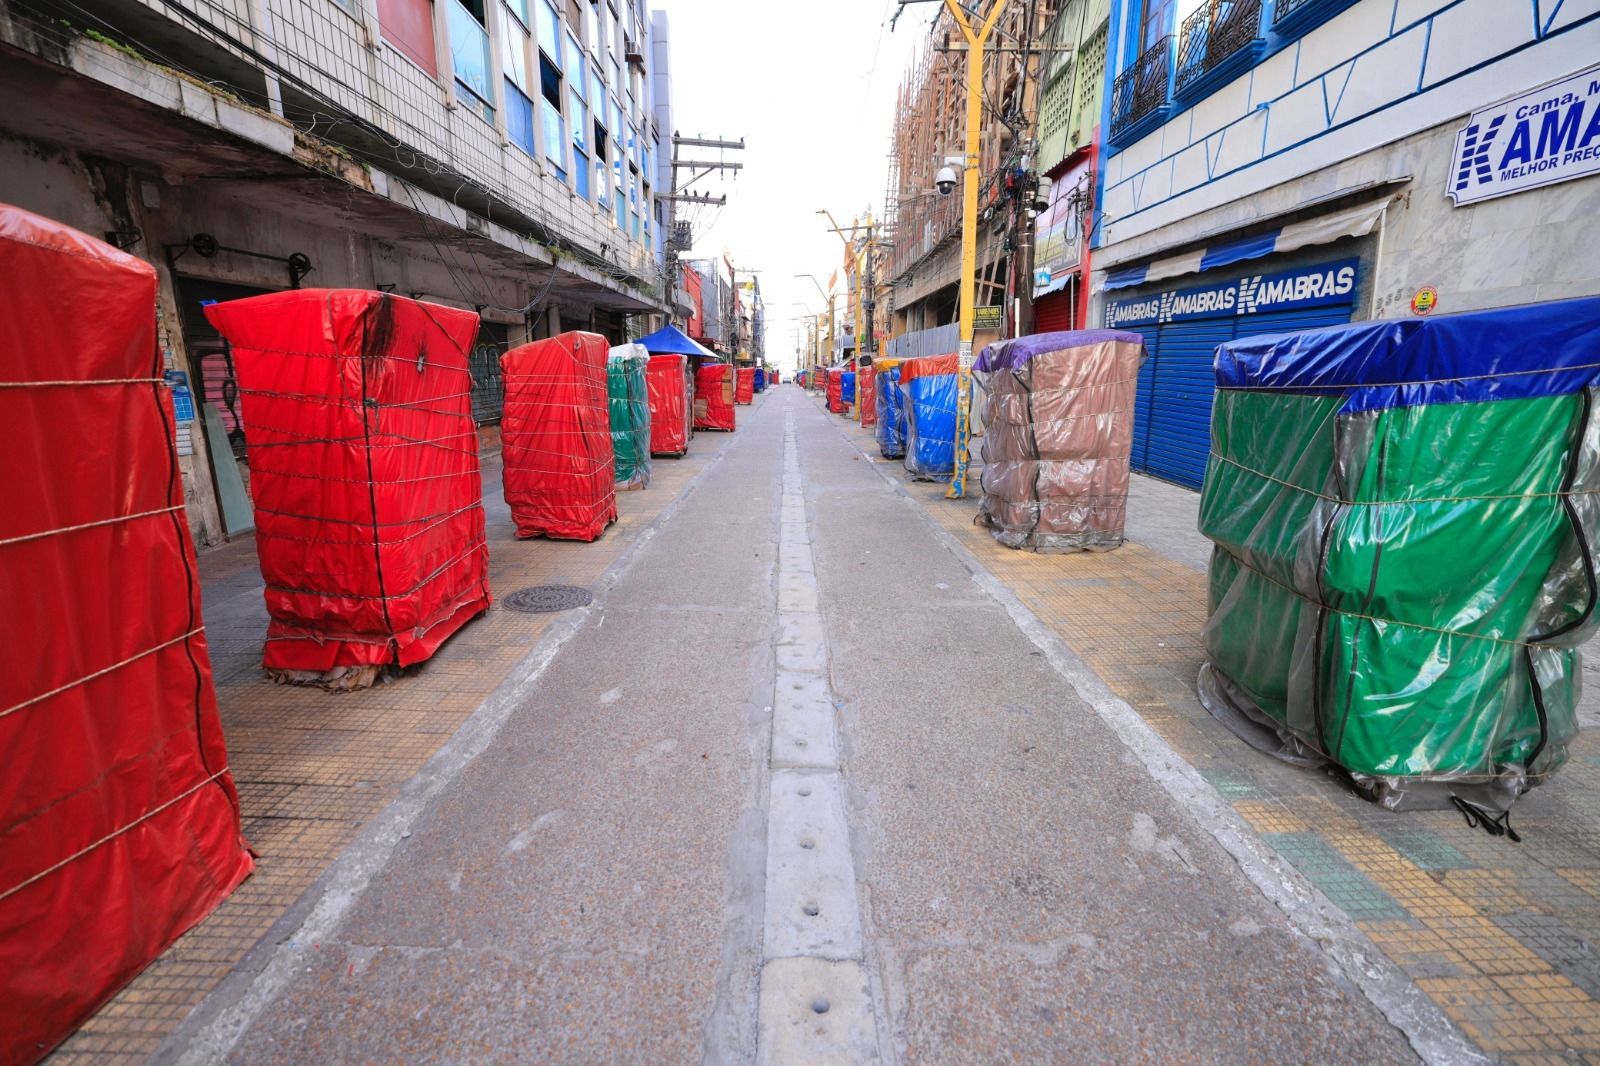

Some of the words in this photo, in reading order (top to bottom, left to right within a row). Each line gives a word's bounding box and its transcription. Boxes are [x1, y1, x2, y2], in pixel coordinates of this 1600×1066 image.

[1516, 92, 1580, 120] Cama,
[1500, 157, 1558, 182] MELHOR
[1105, 302, 1159, 328] KAMABRAS
[1159, 287, 1236, 323] KAMABRAS
[1237, 267, 1355, 314] KAMABRAS
